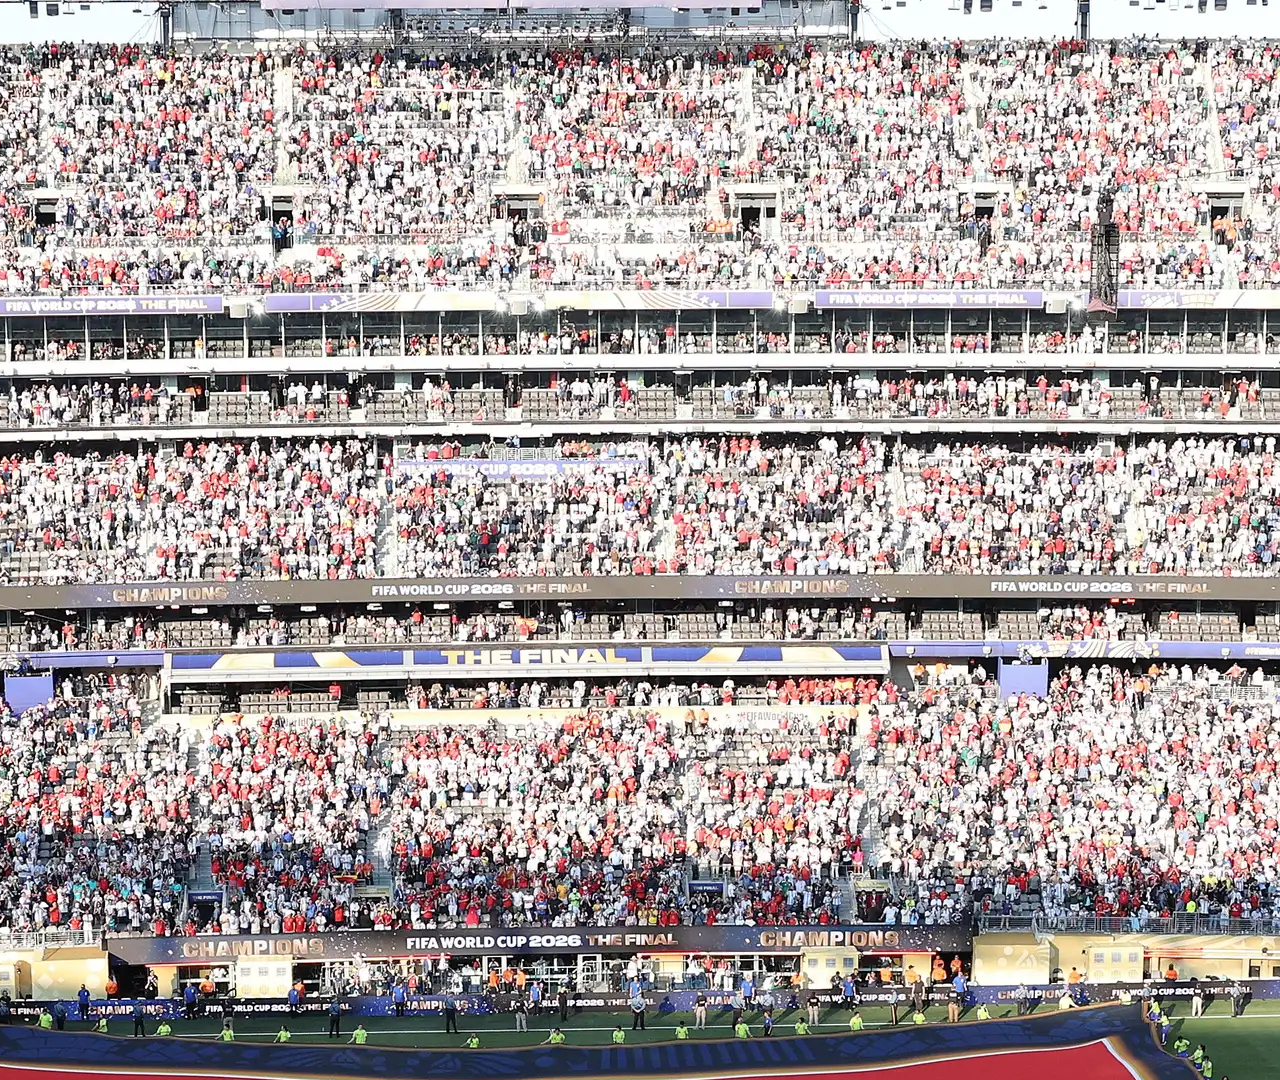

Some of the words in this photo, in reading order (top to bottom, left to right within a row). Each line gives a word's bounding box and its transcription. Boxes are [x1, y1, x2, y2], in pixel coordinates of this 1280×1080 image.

[113, 586, 227, 602] CHAMPIONS
[372, 585, 398, 596] FIFA
[400, 585, 444, 596] WORLD
[445, 584, 469, 595] CUP
[470, 584, 514, 594] 2026
[517, 583, 546, 593] THE
[548, 583, 591, 593] FINAL
[734, 580, 848, 593] CHAMPIONS
[990, 582, 1016, 592] FIFA
[1018, 582, 1062, 592] WORLD
[1064, 582, 1088, 592] CUP
[1090, 582, 1133, 592] 2026
[1136, 582, 1166, 592] THE
[1168, 583, 1211, 593] FINAL
[441, 649, 512, 664] THE
[519, 648, 627, 663] FINAL
[407, 937, 439, 949] FIFA
[440, 936, 494, 949] WORLD
[496, 936, 527, 948] CUP
[529, 934, 581, 947] 2026
[586, 934, 623, 946] THE
[625, 933, 679, 945] FINAL
[760, 930, 899, 947] CHAMPIONS
[183, 938, 324, 957] CHAMPIONS
